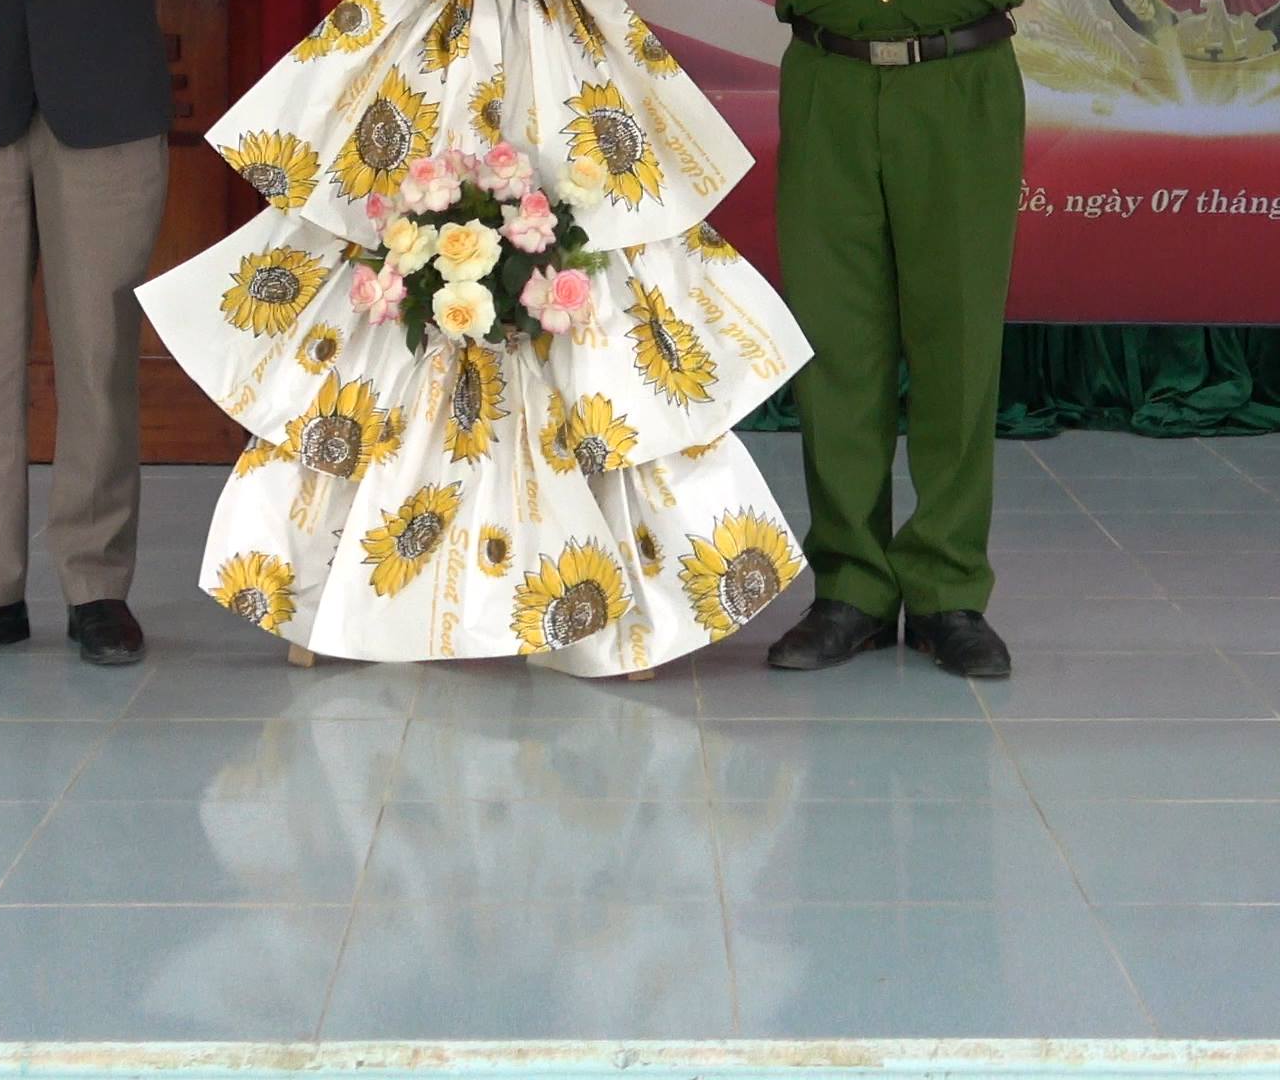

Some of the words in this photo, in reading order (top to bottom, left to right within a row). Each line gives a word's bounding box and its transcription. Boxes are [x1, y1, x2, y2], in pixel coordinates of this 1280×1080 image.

[664, 135, 719, 198] Silent
[1063, 188, 1145, 219] ngày
[1151, 188, 1189, 214] 07
[687, 287, 725, 325] love
[719, 322, 781, 380] Silent
[443, 523, 469, 605] Silent
[440, 611, 461, 657] love
